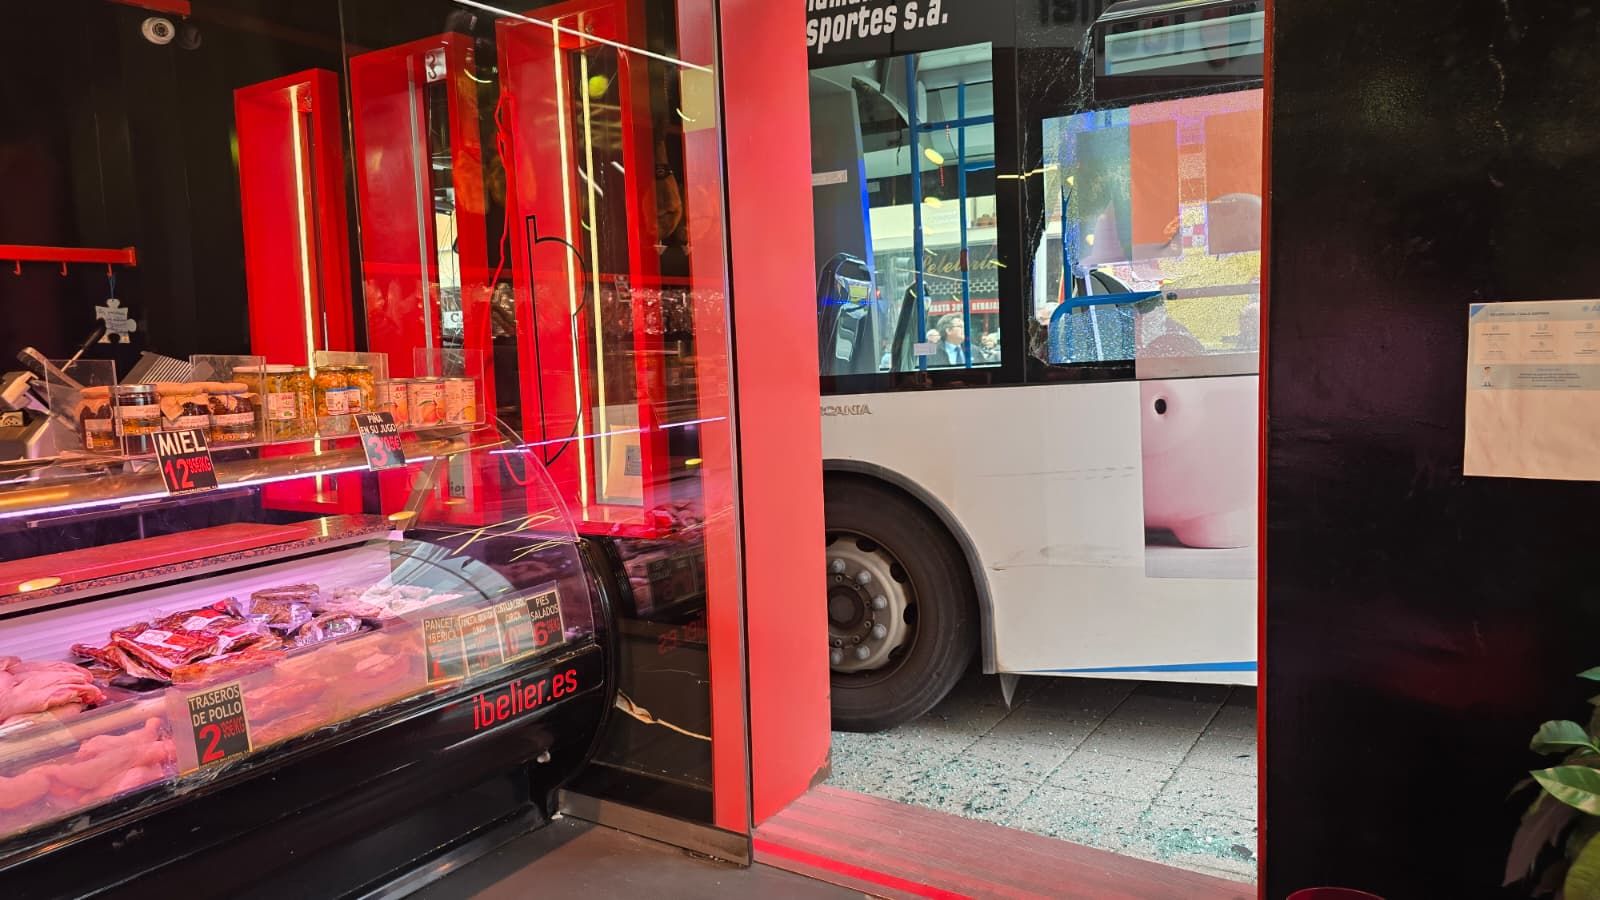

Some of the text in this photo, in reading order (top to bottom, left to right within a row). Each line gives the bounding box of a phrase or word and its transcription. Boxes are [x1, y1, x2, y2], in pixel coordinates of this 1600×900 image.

[806, 0, 949, 54] sportes s.a.
[158, 430, 207, 457] MIEL
[188, 685, 240, 711] TRASEROS
[472, 669, 577, 730] ibelier.es
[192, 701, 242, 728] DE POLLO
